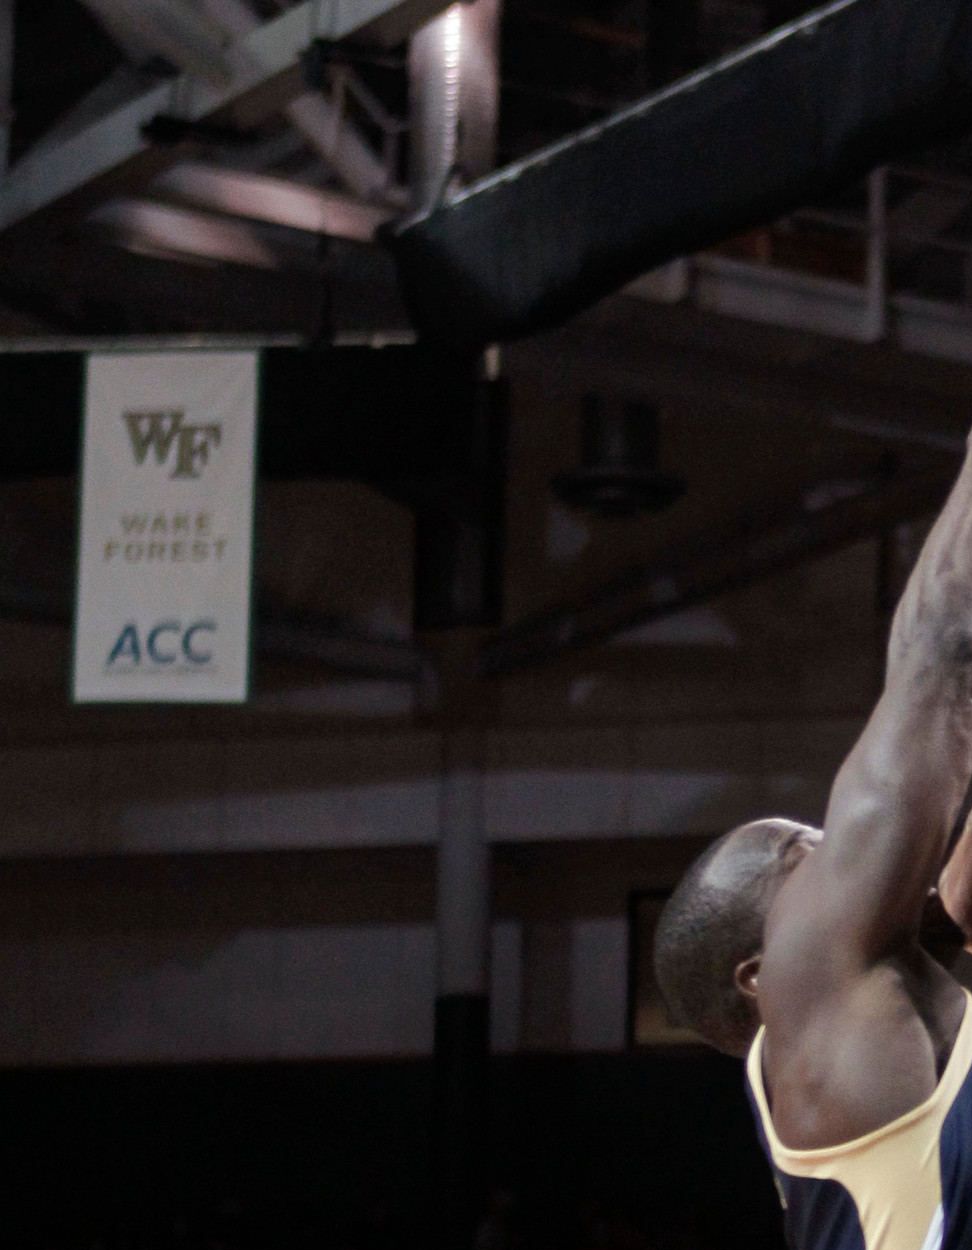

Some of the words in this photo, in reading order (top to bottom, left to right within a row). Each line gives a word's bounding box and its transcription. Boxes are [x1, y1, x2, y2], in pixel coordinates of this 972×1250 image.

[119, 512, 213, 535] WAKE
[104, 538, 228, 564] FOREST
[105, 617, 217, 666] ACC
